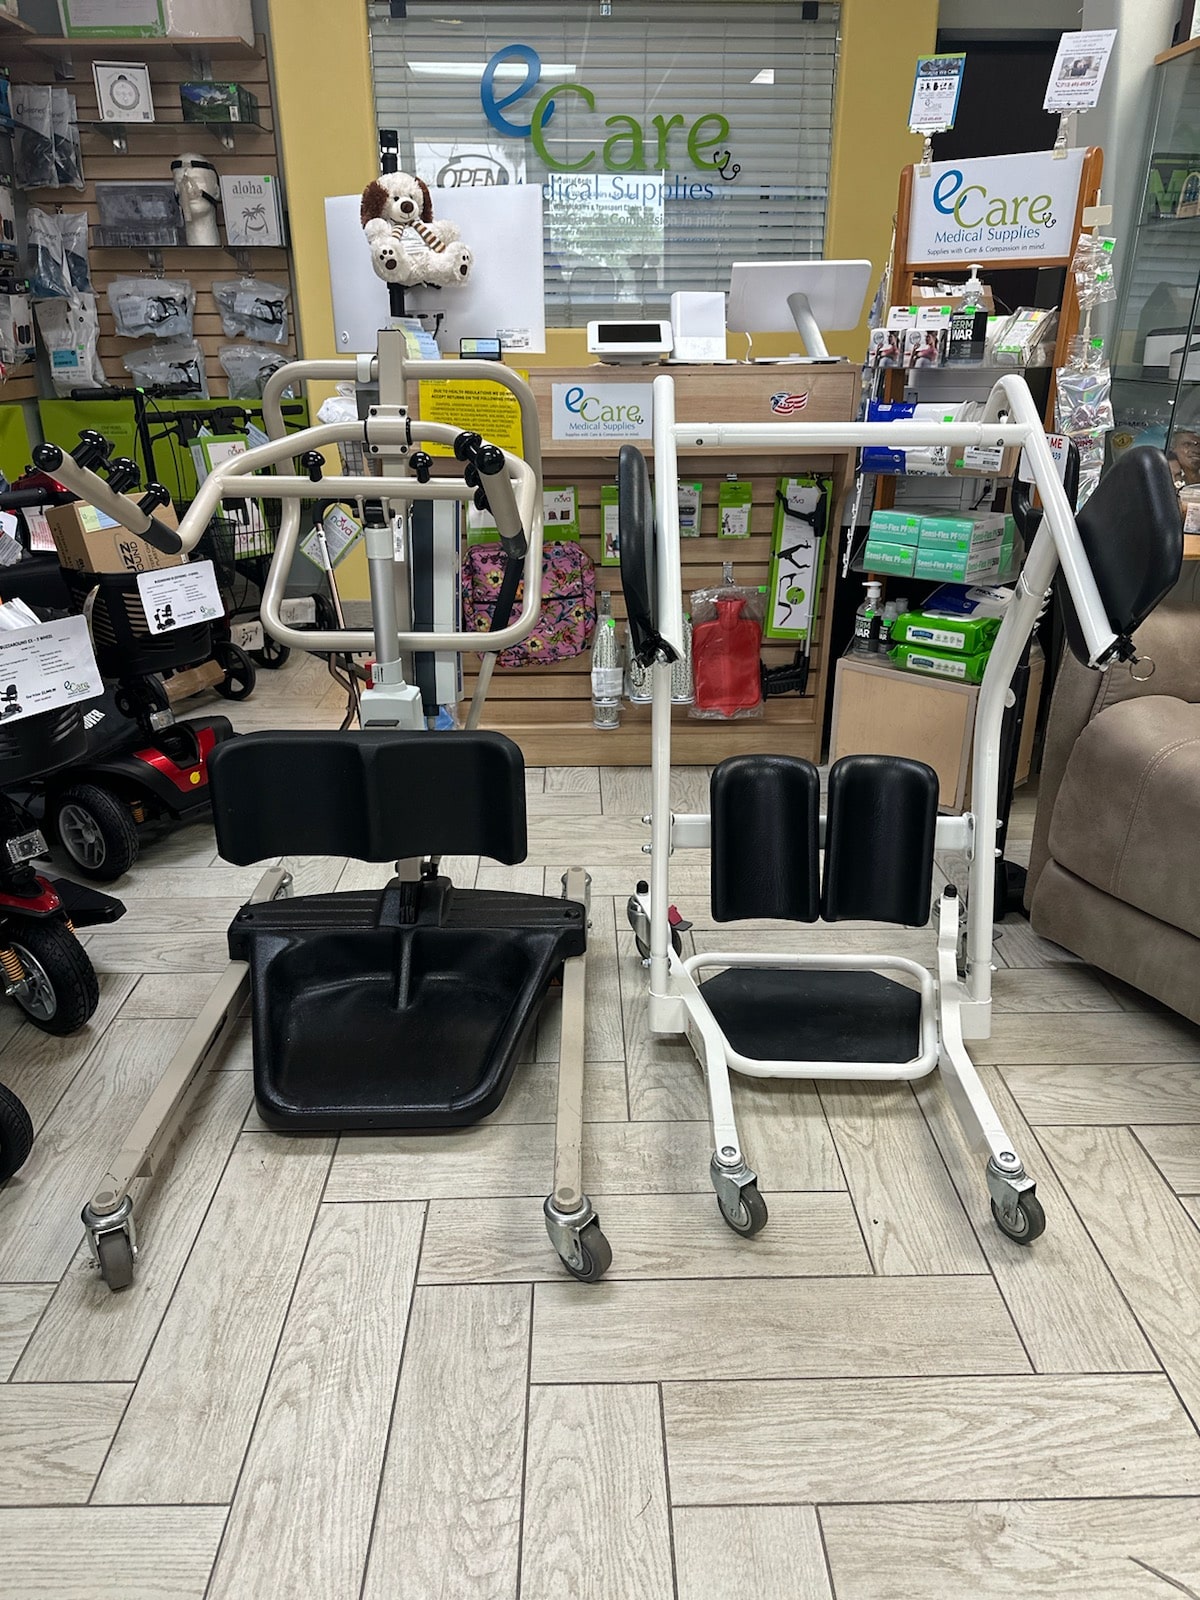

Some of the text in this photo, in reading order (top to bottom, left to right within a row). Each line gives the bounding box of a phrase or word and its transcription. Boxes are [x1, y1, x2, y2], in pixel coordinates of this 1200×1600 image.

[232, 181, 263, 196] aloha
[611, 175, 714, 206] Supplies
[933, 169, 1053, 228] eCare
[934, 226, 1040, 243] Medical Supplies
[927, 247, 949, 256] Supplies
[964, 246, 977, 254] Care
[985, 245, 1021, 254] Compassion
[952, 319, 974, 330] GERM
[951, 329, 973, 341] WAR
[565, 387, 641, 422] eCare
[569, 422, 636, 431] Medical Supplies
[330, 515, 353, 537] nova
[921, 529, 949, 540] Semi-Flex
